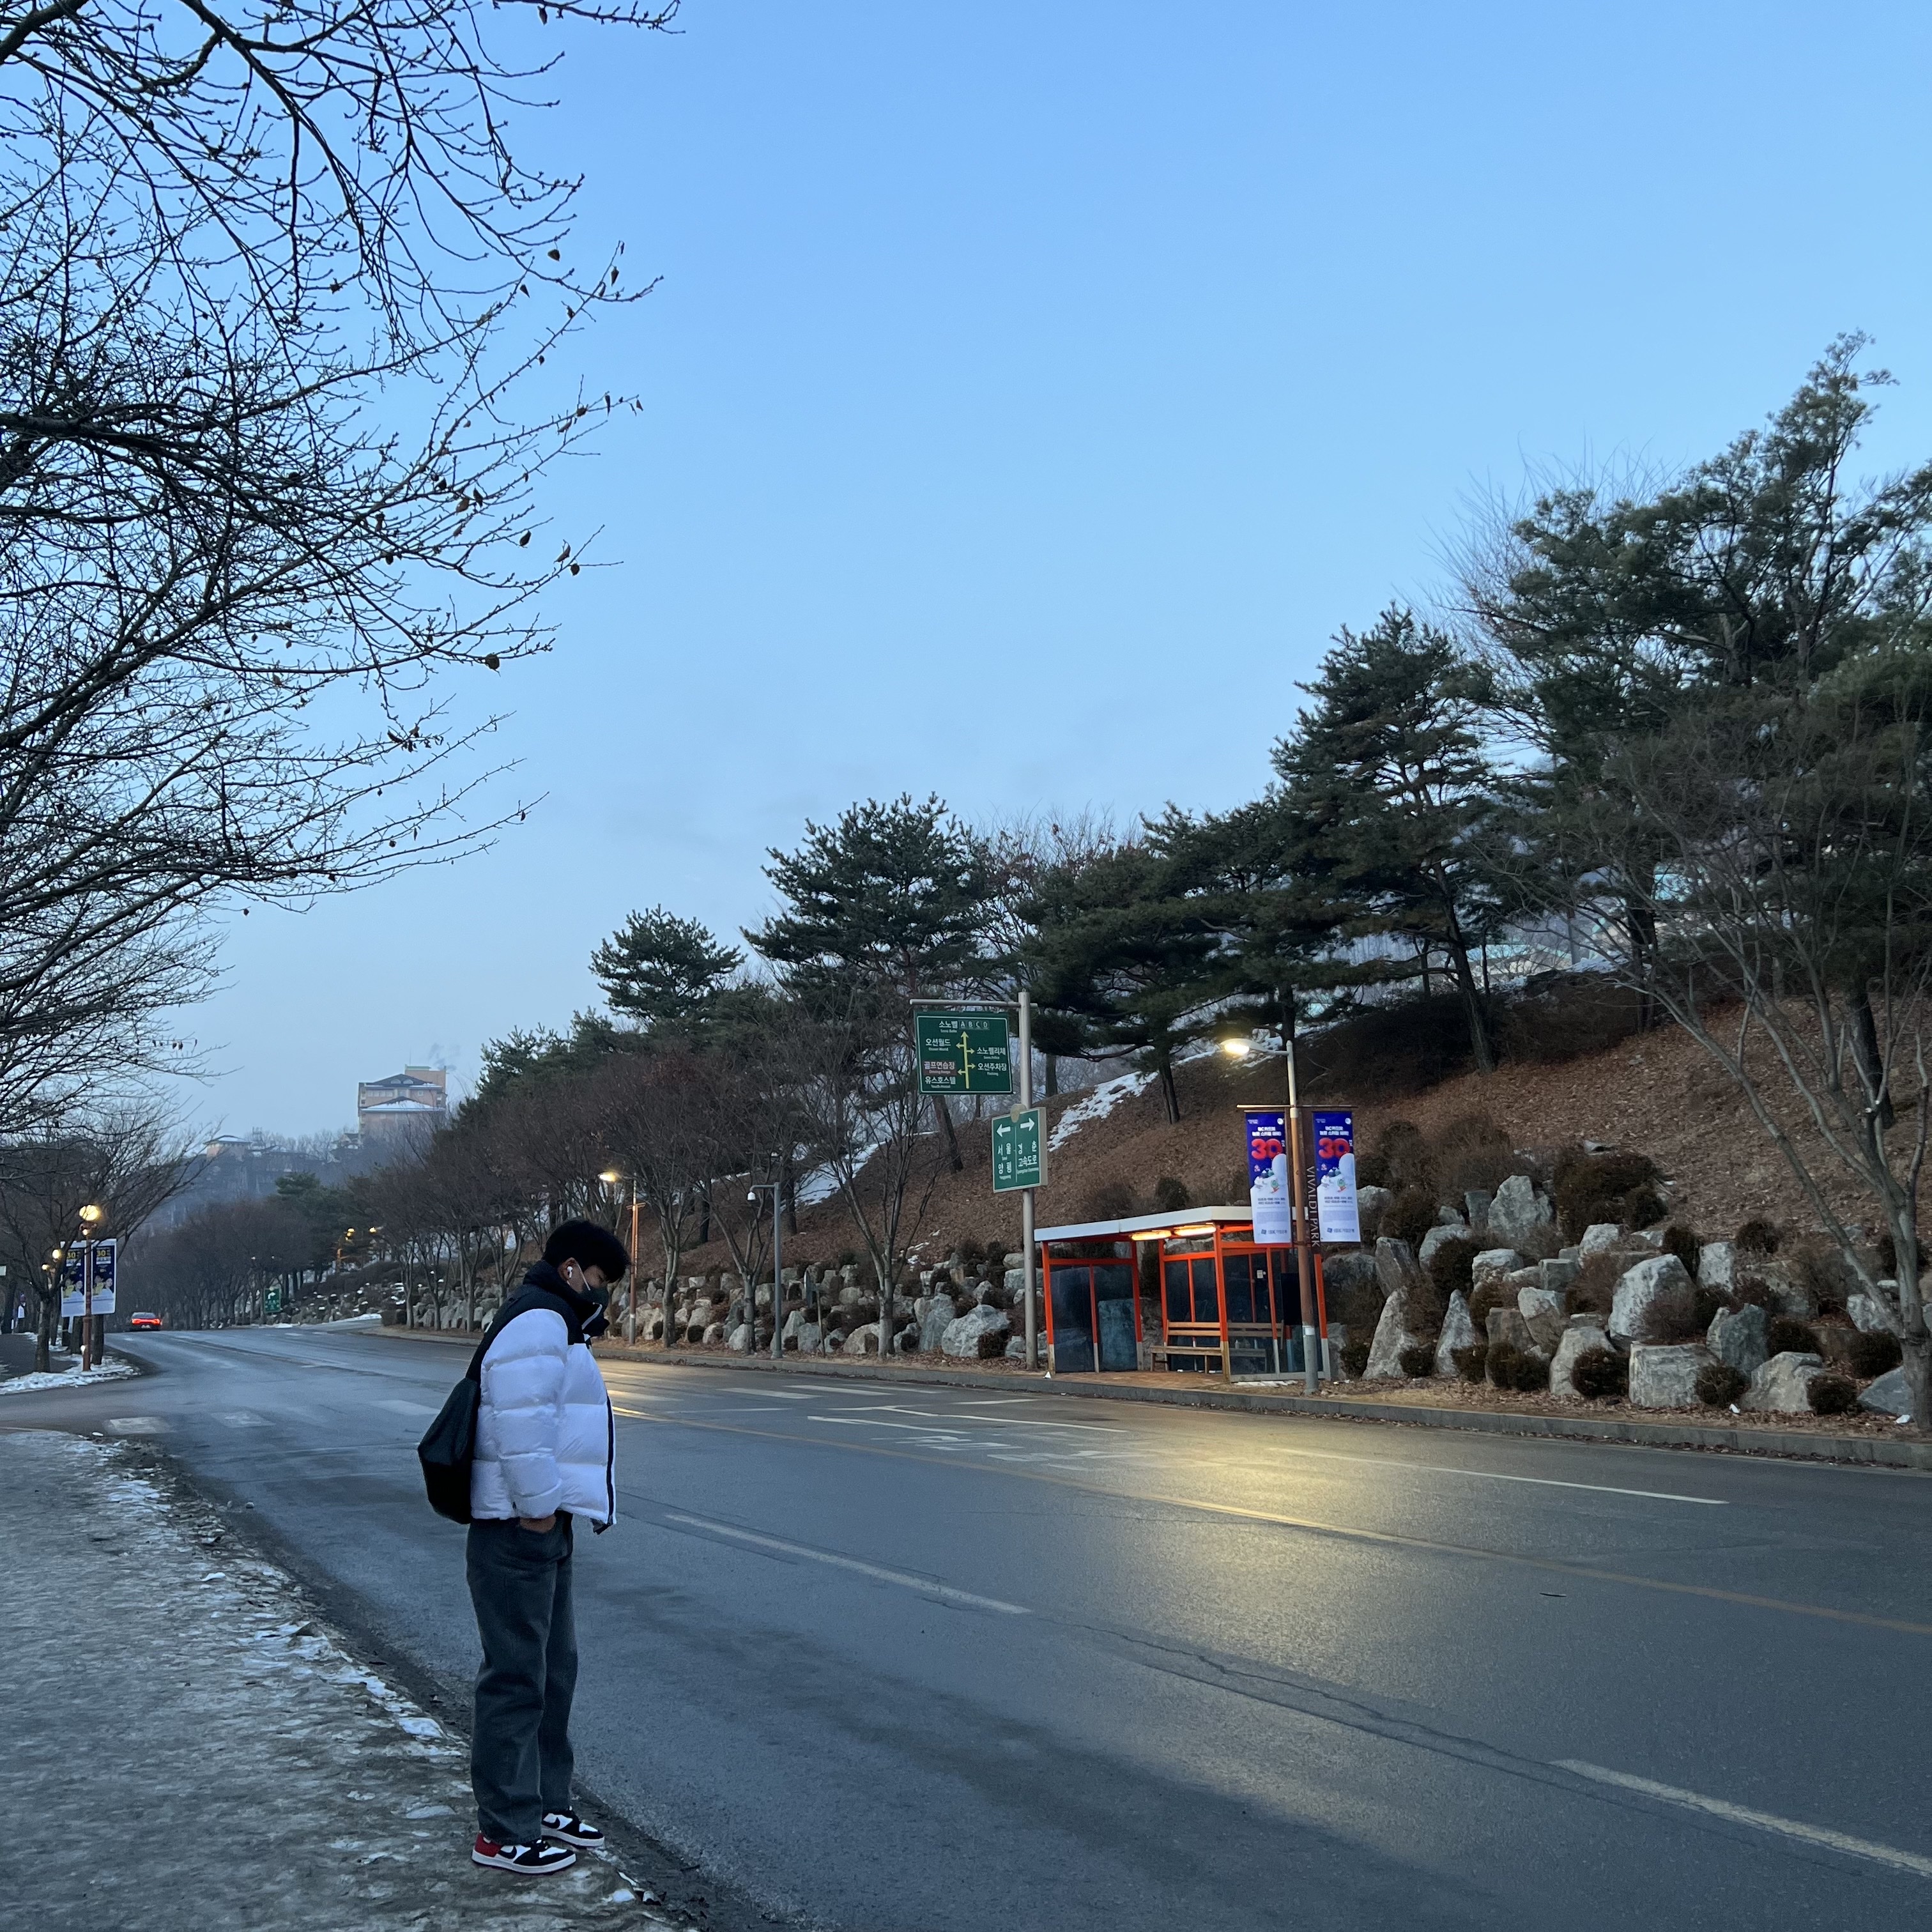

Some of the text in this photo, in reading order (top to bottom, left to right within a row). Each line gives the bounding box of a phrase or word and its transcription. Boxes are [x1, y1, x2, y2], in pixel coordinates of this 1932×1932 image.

[926, 1038, 951, 1046] 오션월드
[924, 1061, 954, 1070] 골프연습장
[977, 1062, 1007, 1071] 오션주차장
[925, 1076, 956, 1084] 유스호스텔
[1252, 1138, 1283, 1160] 30
[1319, 1138, 1350, 1158] 30
[1018, 1154, 1038, 1167] 고속도로
[1306, 1166, 1321, 1248] VIVALDI PARK
